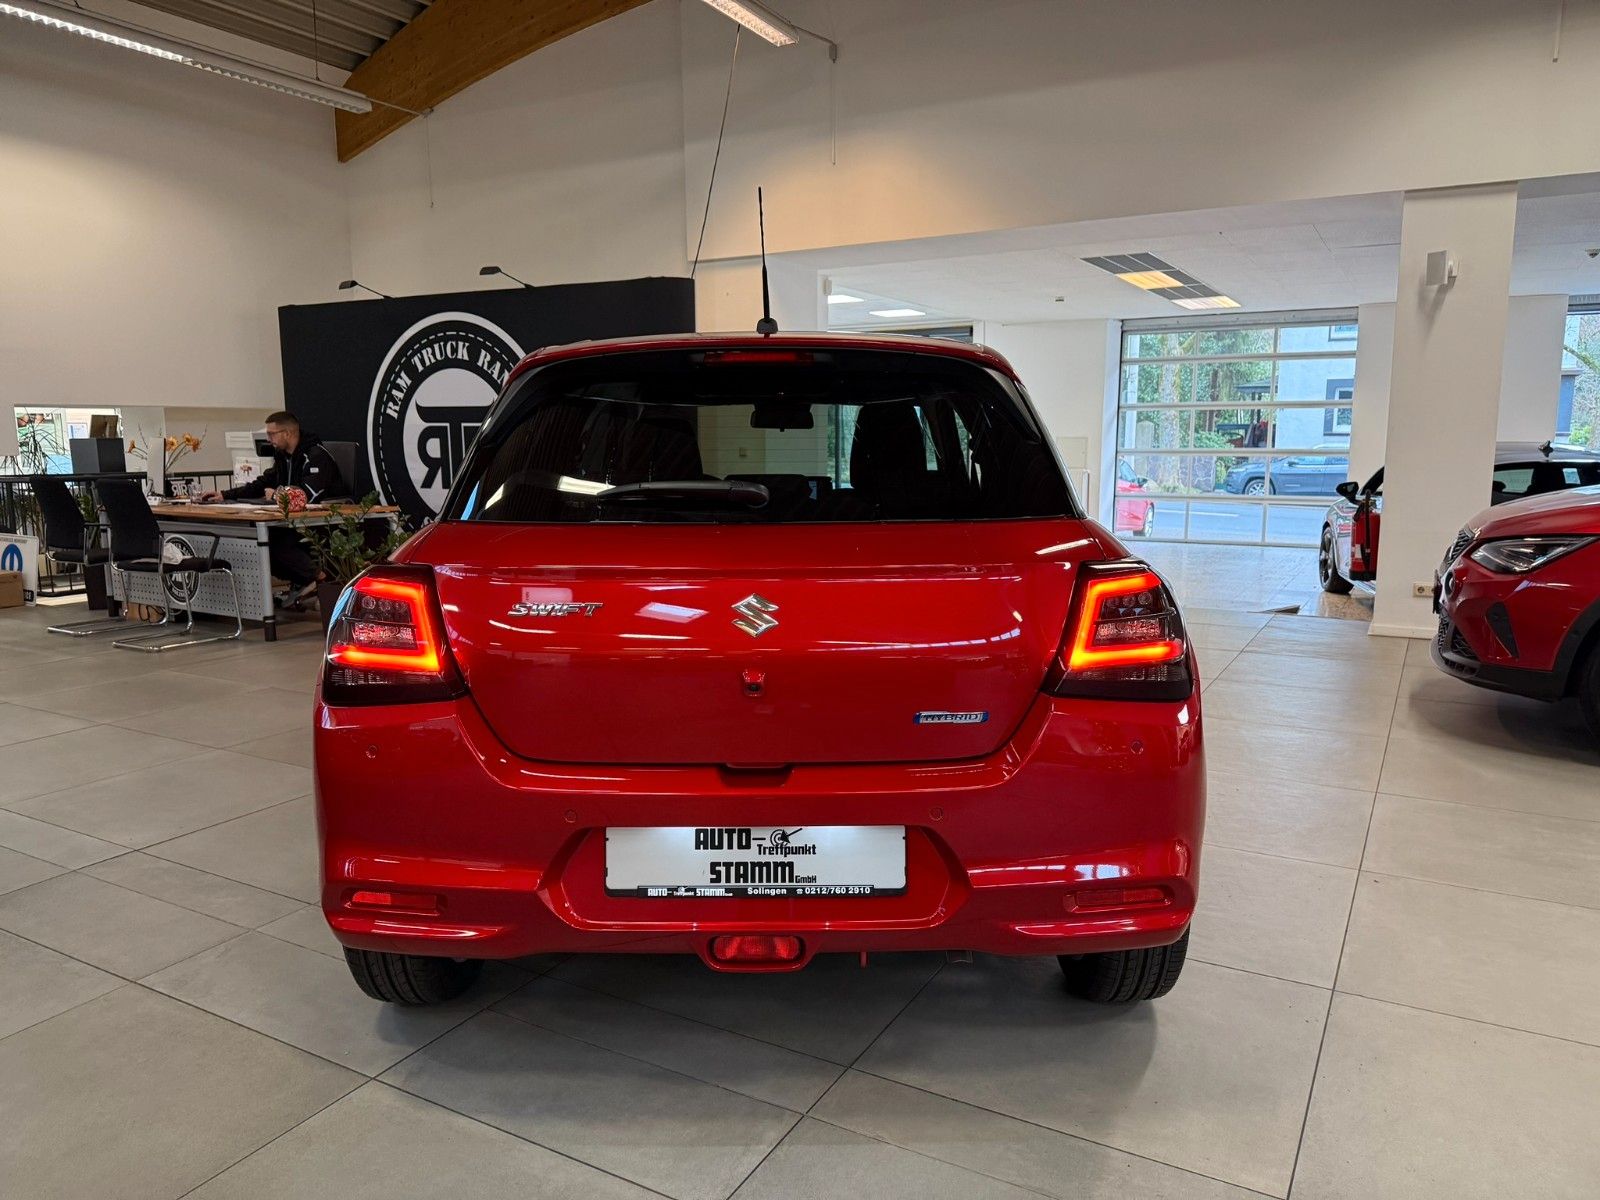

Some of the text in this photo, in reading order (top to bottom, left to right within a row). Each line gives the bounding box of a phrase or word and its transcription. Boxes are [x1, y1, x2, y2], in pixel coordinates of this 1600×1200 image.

[386, 371, 412, 420] RAM
[411, 340, 470, 373] TRUCK
[507, 602, 603, 617] SWIFT
[757, 843, 817, 857] Treffpunkt
[709, 861, 817, 884] STAMM GmbH
[695, 888, 726, 897] STAMM
[747, 887, 787, 896] Solingen
[805, 886, 846, 894] 0212/760
[848, 886, 871, 894] 2910
